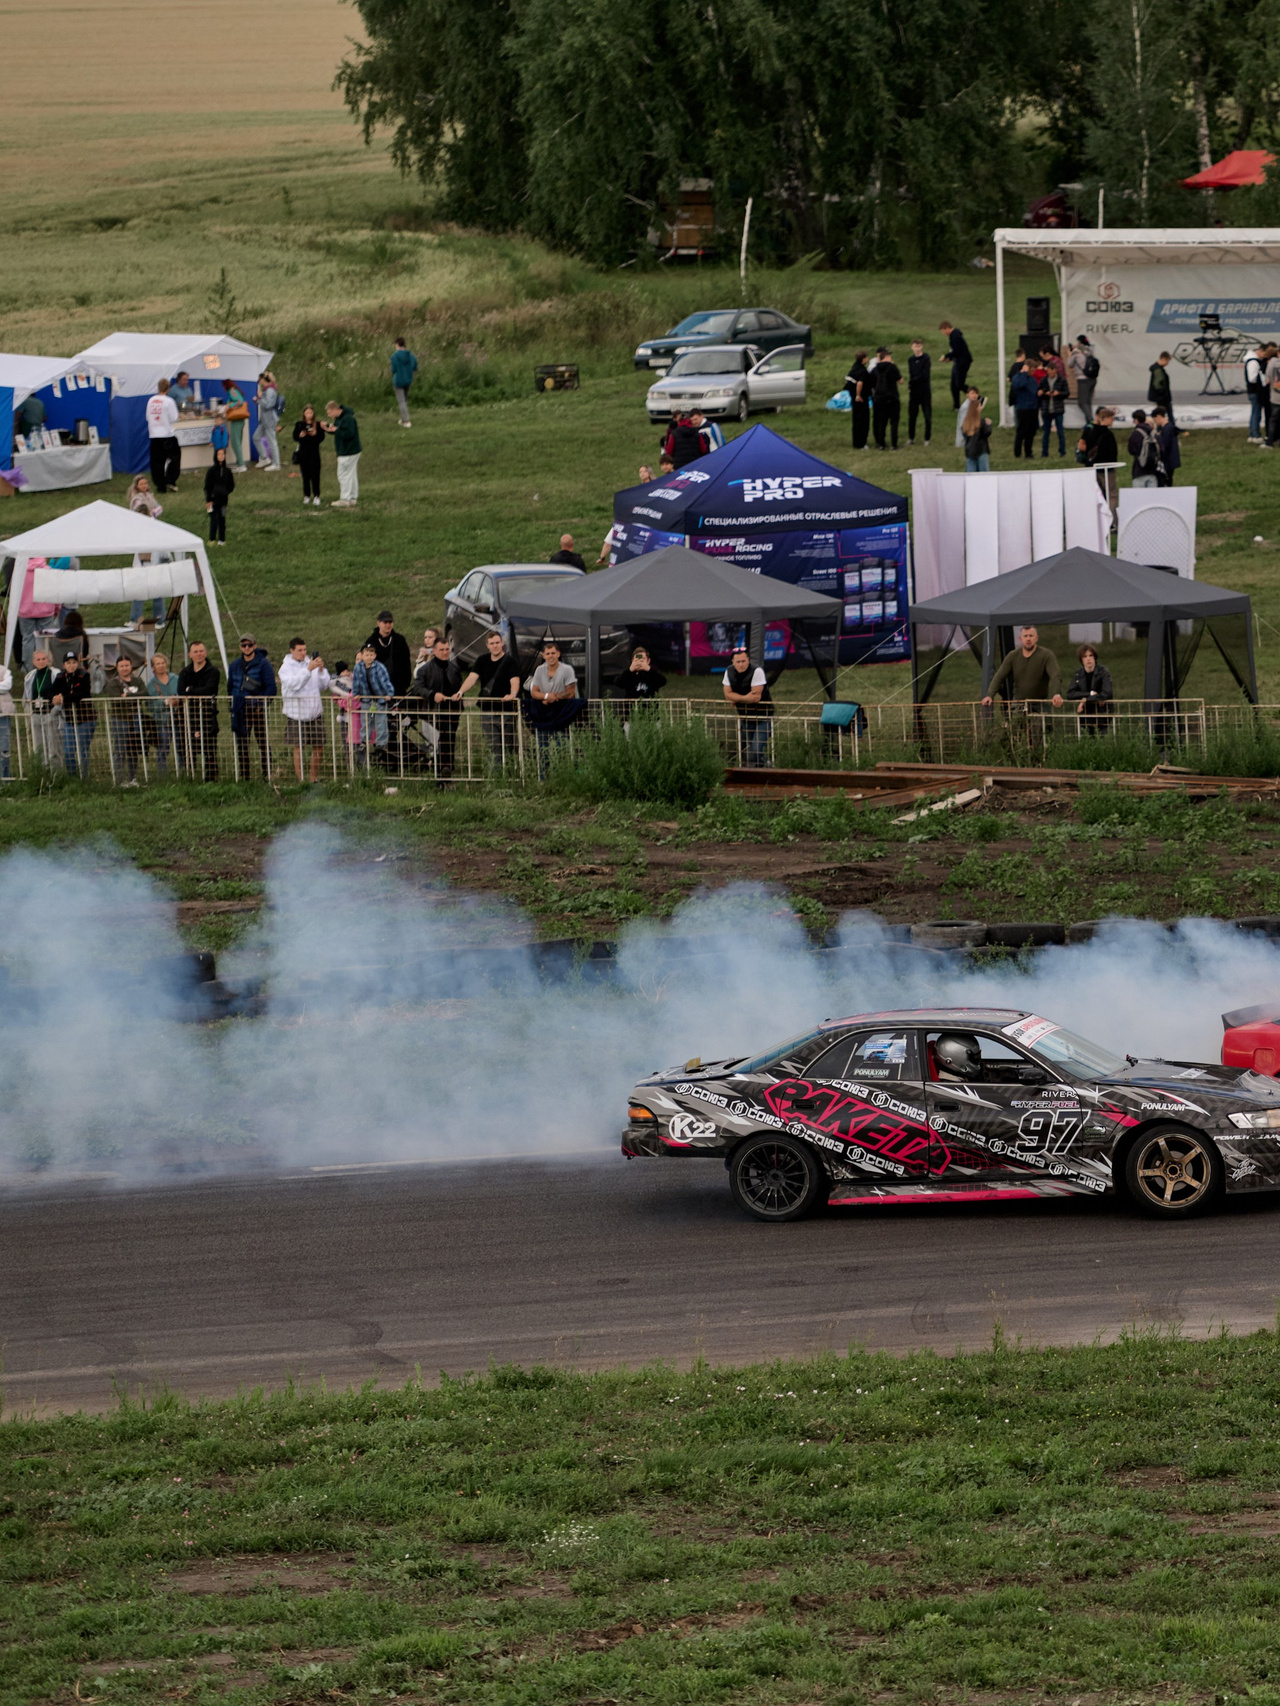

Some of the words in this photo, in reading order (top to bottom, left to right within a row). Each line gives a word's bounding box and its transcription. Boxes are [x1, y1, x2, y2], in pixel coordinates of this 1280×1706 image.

[1086, 301, 1134, 312] СОЮЗ
[1161, 303, 1206, 315] ДРИФТ
[1206, 303, 1216, 314] В
[1086, 324, 1134, 334] RIVER
[743, 477, 842, 490] HYPER
[744, 488, 804, 502] PRO
[704, 513, 804, 526] СПЕЦИАЛИЗИРОВАННЫЕ
[805, 510, 857, 520] ОТРАСЛЕВЫЕ
[859, 507, 897, 518] РЕШЕНИЯ
[706, 538, 745, 547] HYPER
[735, 543, 773, 553] RACING
[691, 1087, 728, 1109] СОЮЗ
[831, 1079, 869, 1098] СОЮЗ
[889, 1100, 927, 1121] СОЮЗ
[1141, 1103, 1185, 1112] PONULYAM
[747, 1107, 785, 1129] СОЮЗ
[764, 1078, 952, 1175] РАКЕТА
[804, 1127, 844, 1154] СОЮЗ
[1015, 1109, 1091, 1155] 97
[866, 1153, 905, 1175] СОЮЗ
[1007, 1146, 1046, 1168] СОЮЗ
